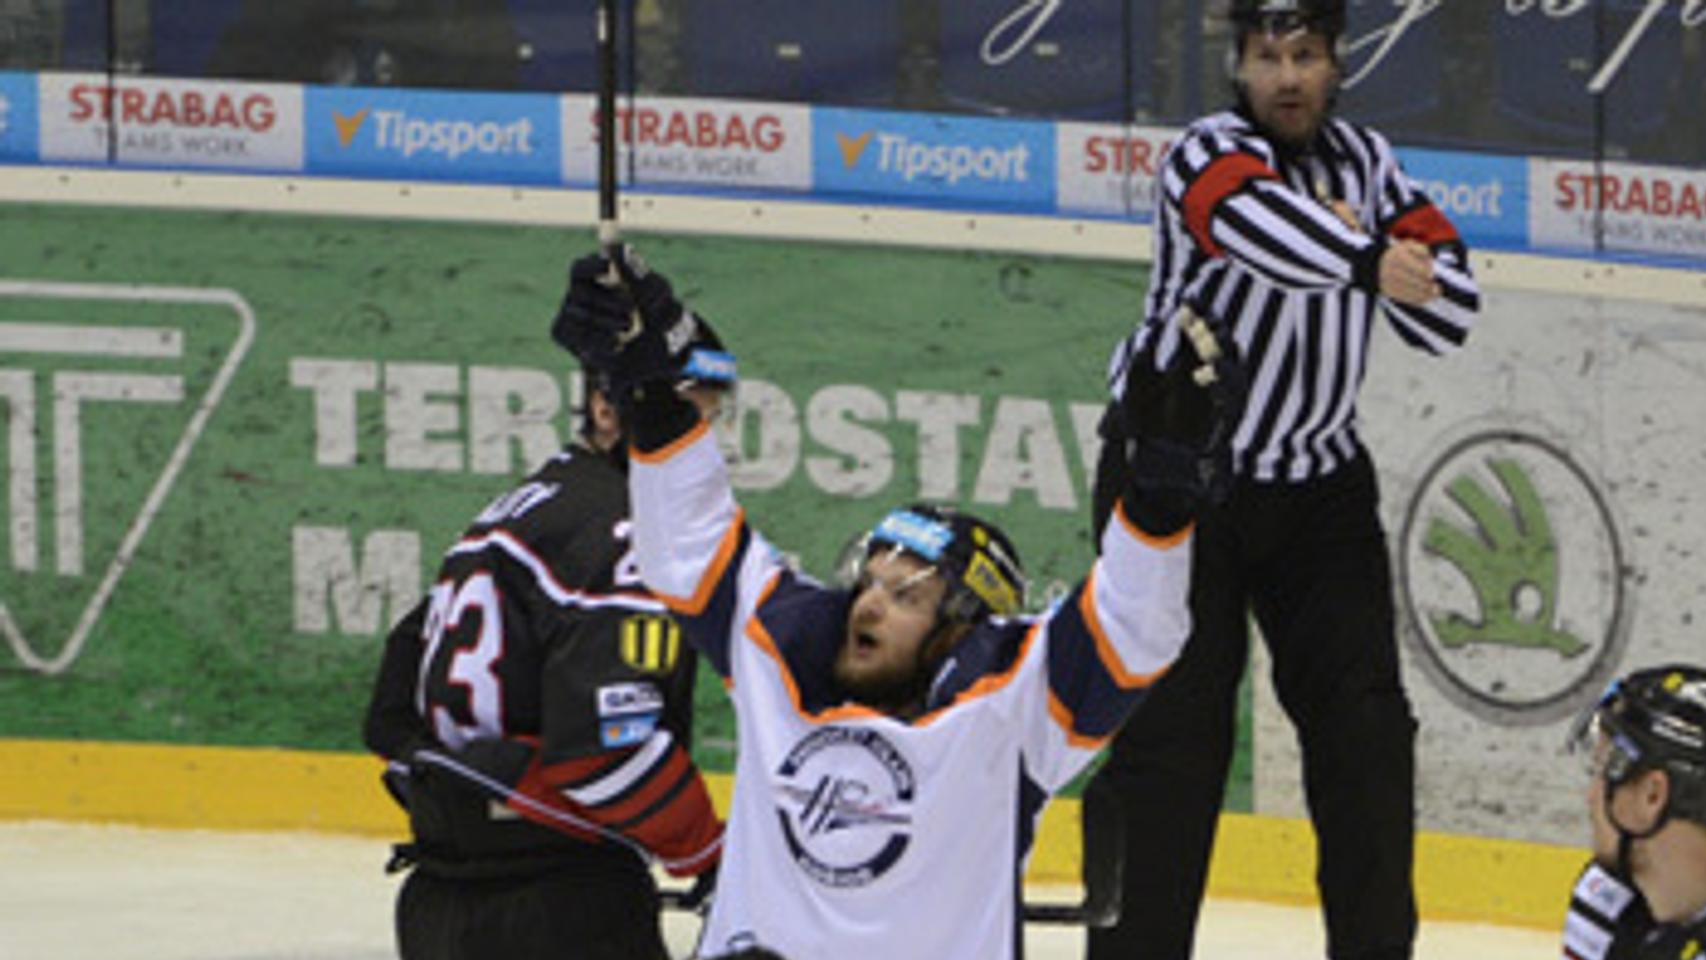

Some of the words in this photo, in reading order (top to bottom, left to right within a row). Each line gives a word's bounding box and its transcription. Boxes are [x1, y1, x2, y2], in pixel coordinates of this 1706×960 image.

[70, 84, 276, 133] STRABAG
[373, 108, 533, 161] Tipsport
[877, 132, 1029, 184] Tipsport
[290, 358, 1107, 511] TEROSTA
